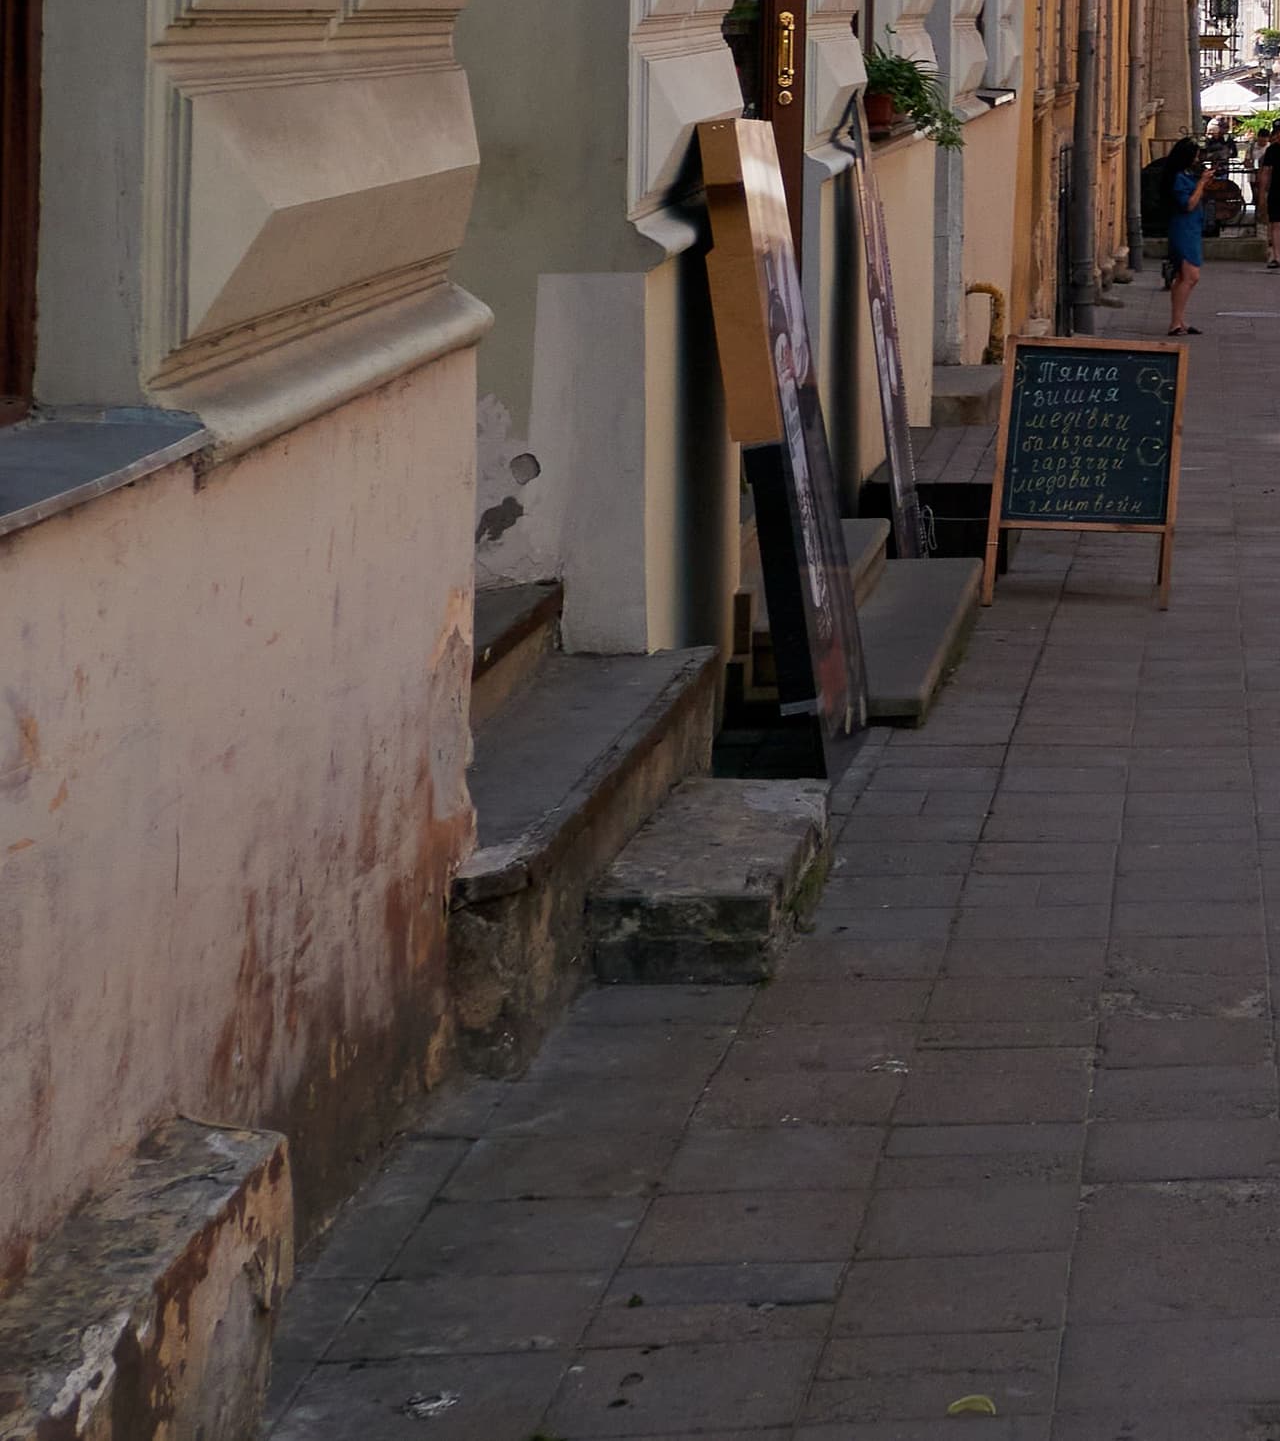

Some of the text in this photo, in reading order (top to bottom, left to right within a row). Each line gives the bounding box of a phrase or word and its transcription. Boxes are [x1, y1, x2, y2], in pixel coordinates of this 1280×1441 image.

[1025, 408, 1132, 433] медівки
[1022, 434, 1130, 455] бальзами
[1014, 470, 1107, 494] медовий
